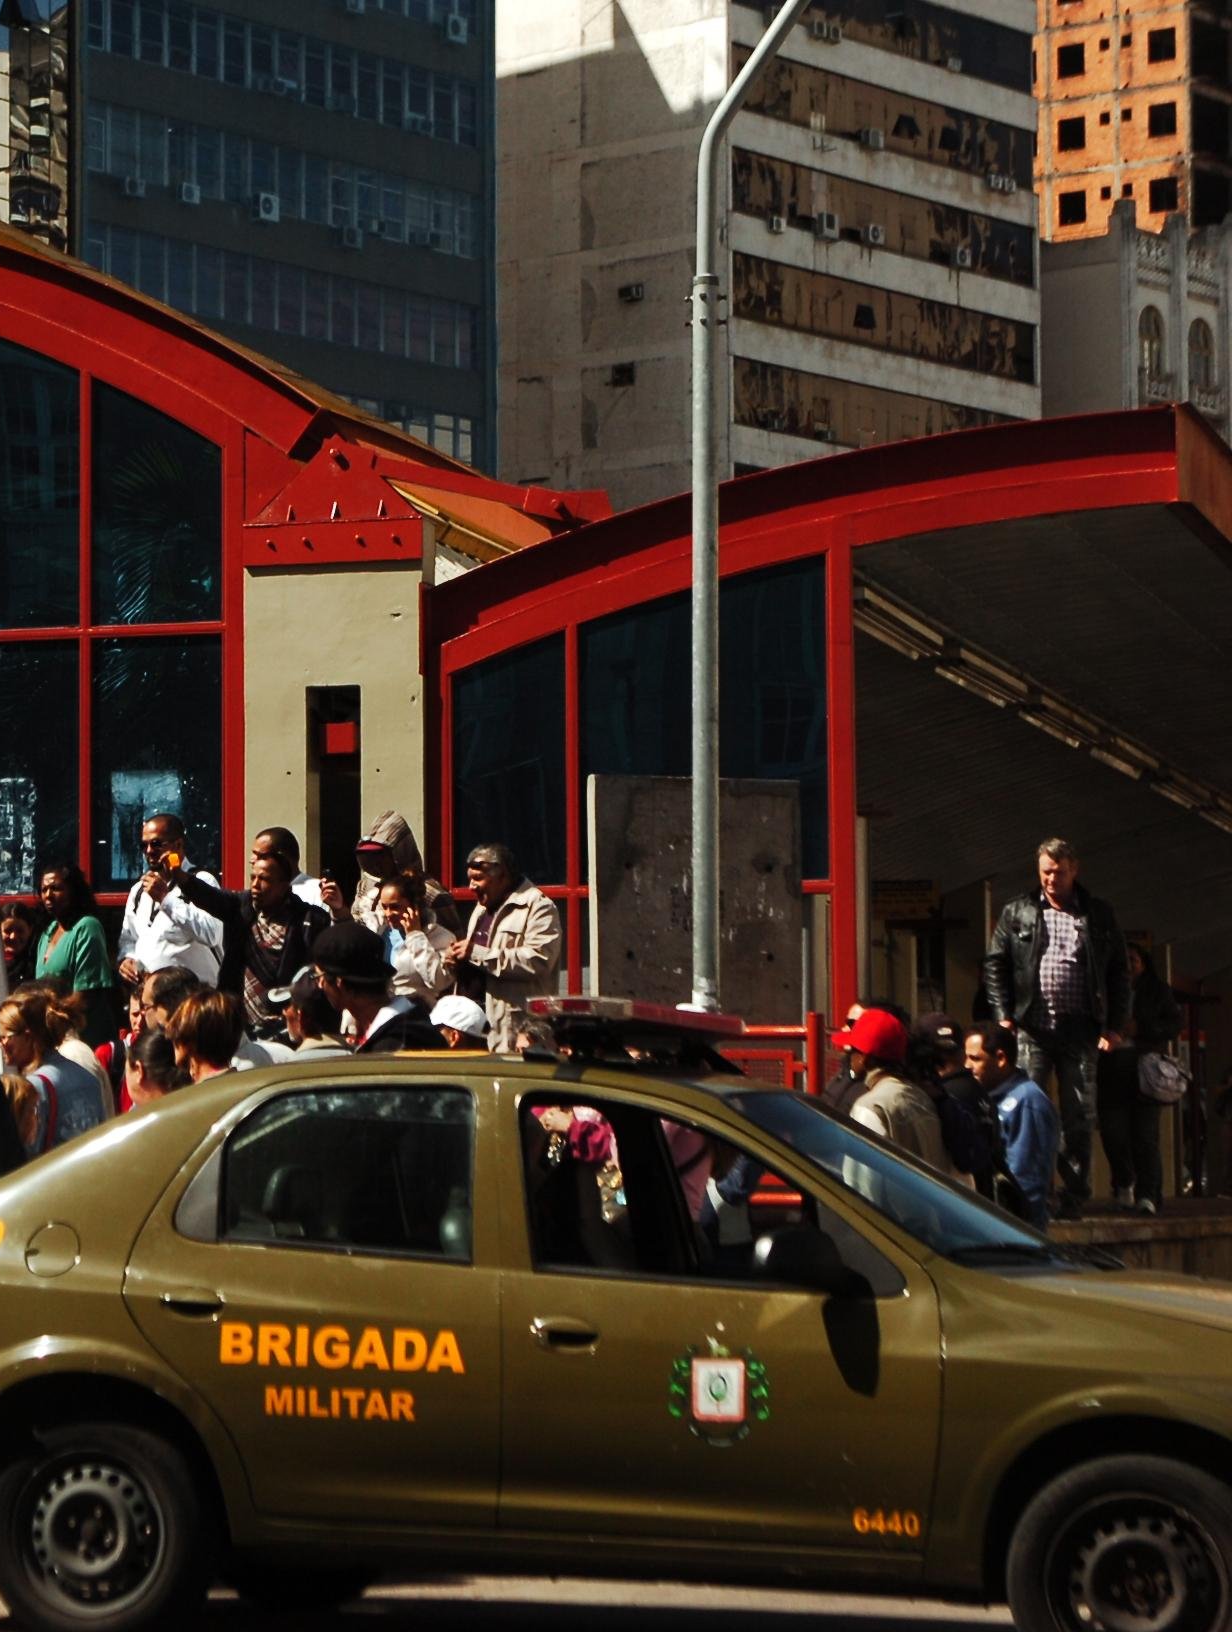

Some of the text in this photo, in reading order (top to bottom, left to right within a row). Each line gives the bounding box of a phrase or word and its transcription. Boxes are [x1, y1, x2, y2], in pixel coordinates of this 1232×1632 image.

[220, 1322, 465, 1374] BRIGADA
[265, 1385, 416, 1422] MILITAR
[852, 1507, 920, 1537] 6440
